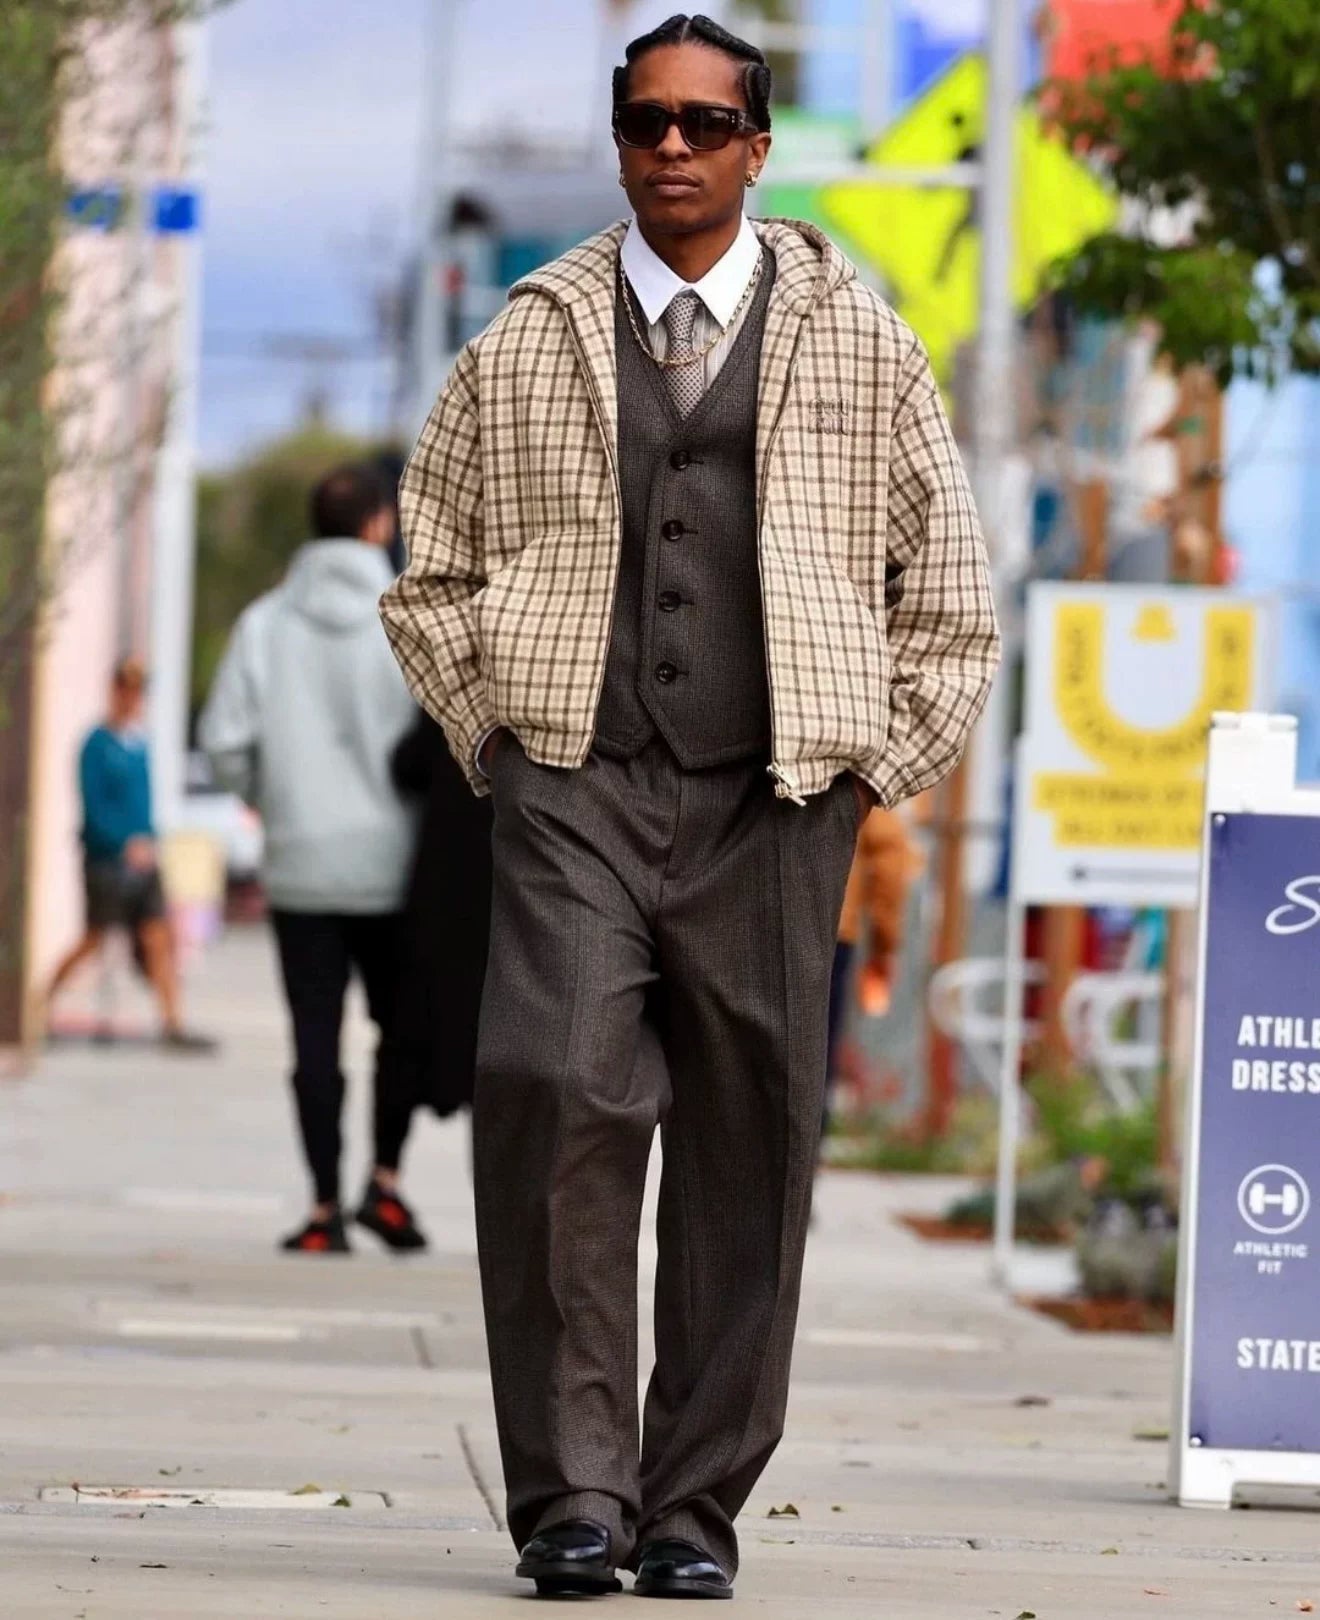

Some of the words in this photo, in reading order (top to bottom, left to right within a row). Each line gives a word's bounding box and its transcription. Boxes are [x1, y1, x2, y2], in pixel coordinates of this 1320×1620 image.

[1232, 1059, 1320, 1094] DRESS
[1233, 1241, 1307, 1258] ATHLETIC
[1258, 1260, 1282, 1274] FIT
[1237, 1337, 1320, 1371] STATE
